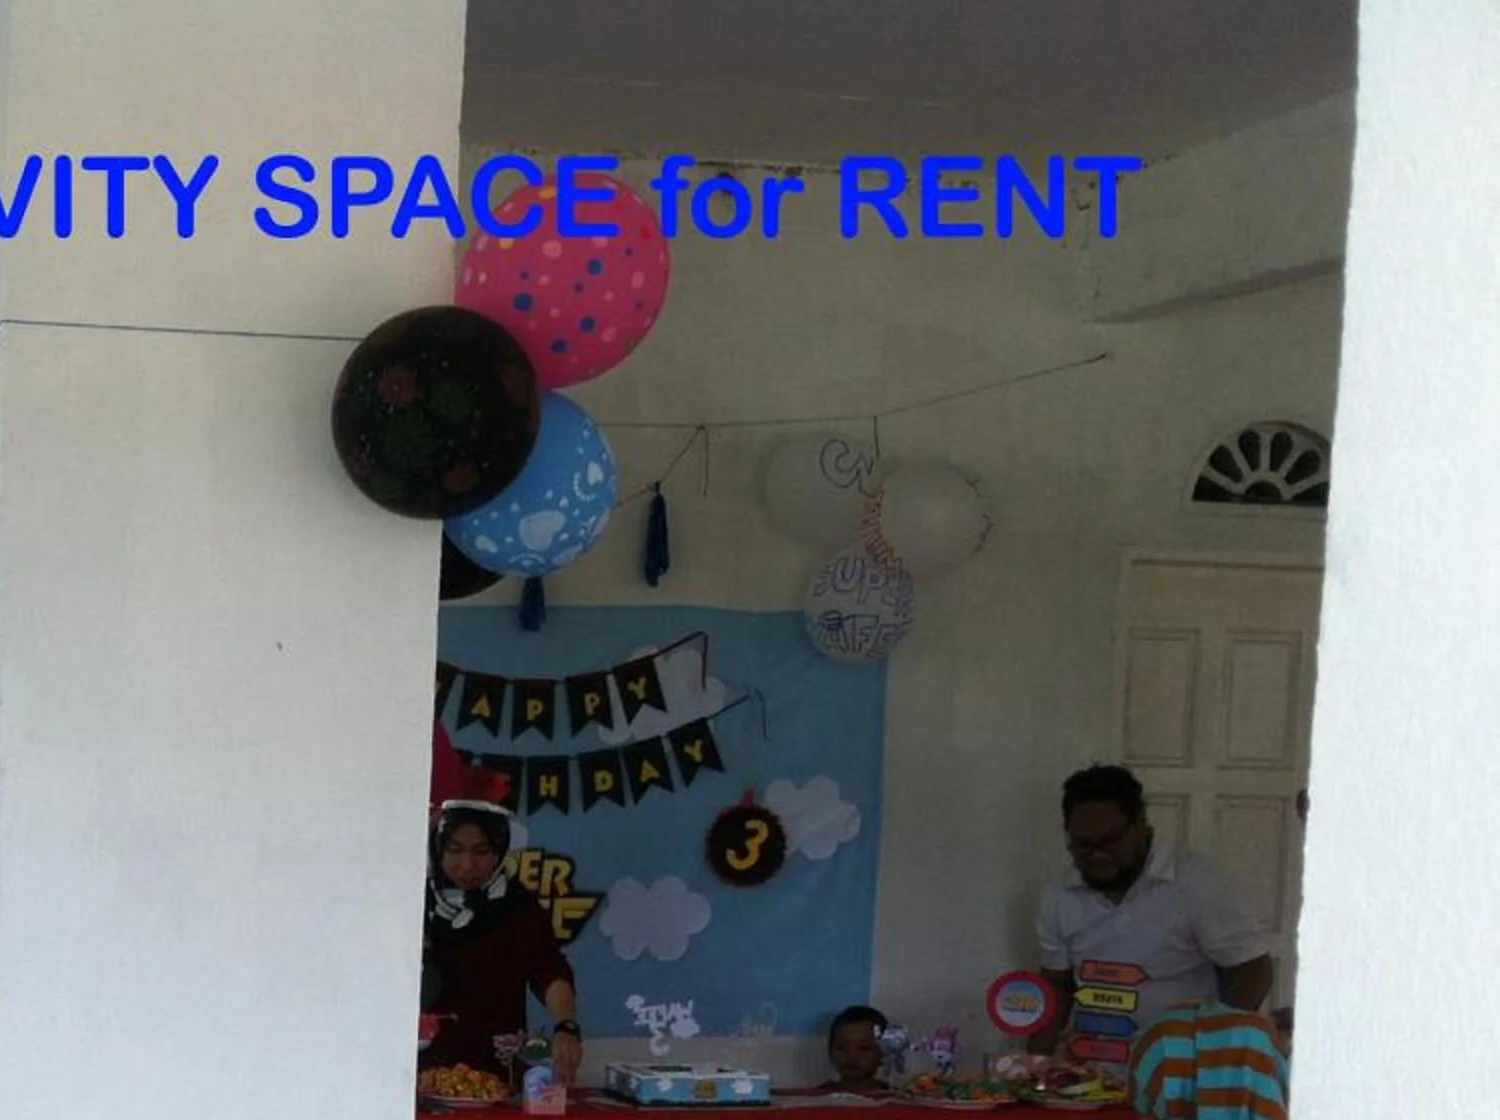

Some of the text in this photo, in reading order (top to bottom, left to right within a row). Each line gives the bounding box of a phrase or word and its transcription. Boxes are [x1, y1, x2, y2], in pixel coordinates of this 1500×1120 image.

[436, 676, 647, 722] APPY
[539, 738, 704, 797] HDAY
[725, 819, 769, 871] 3
